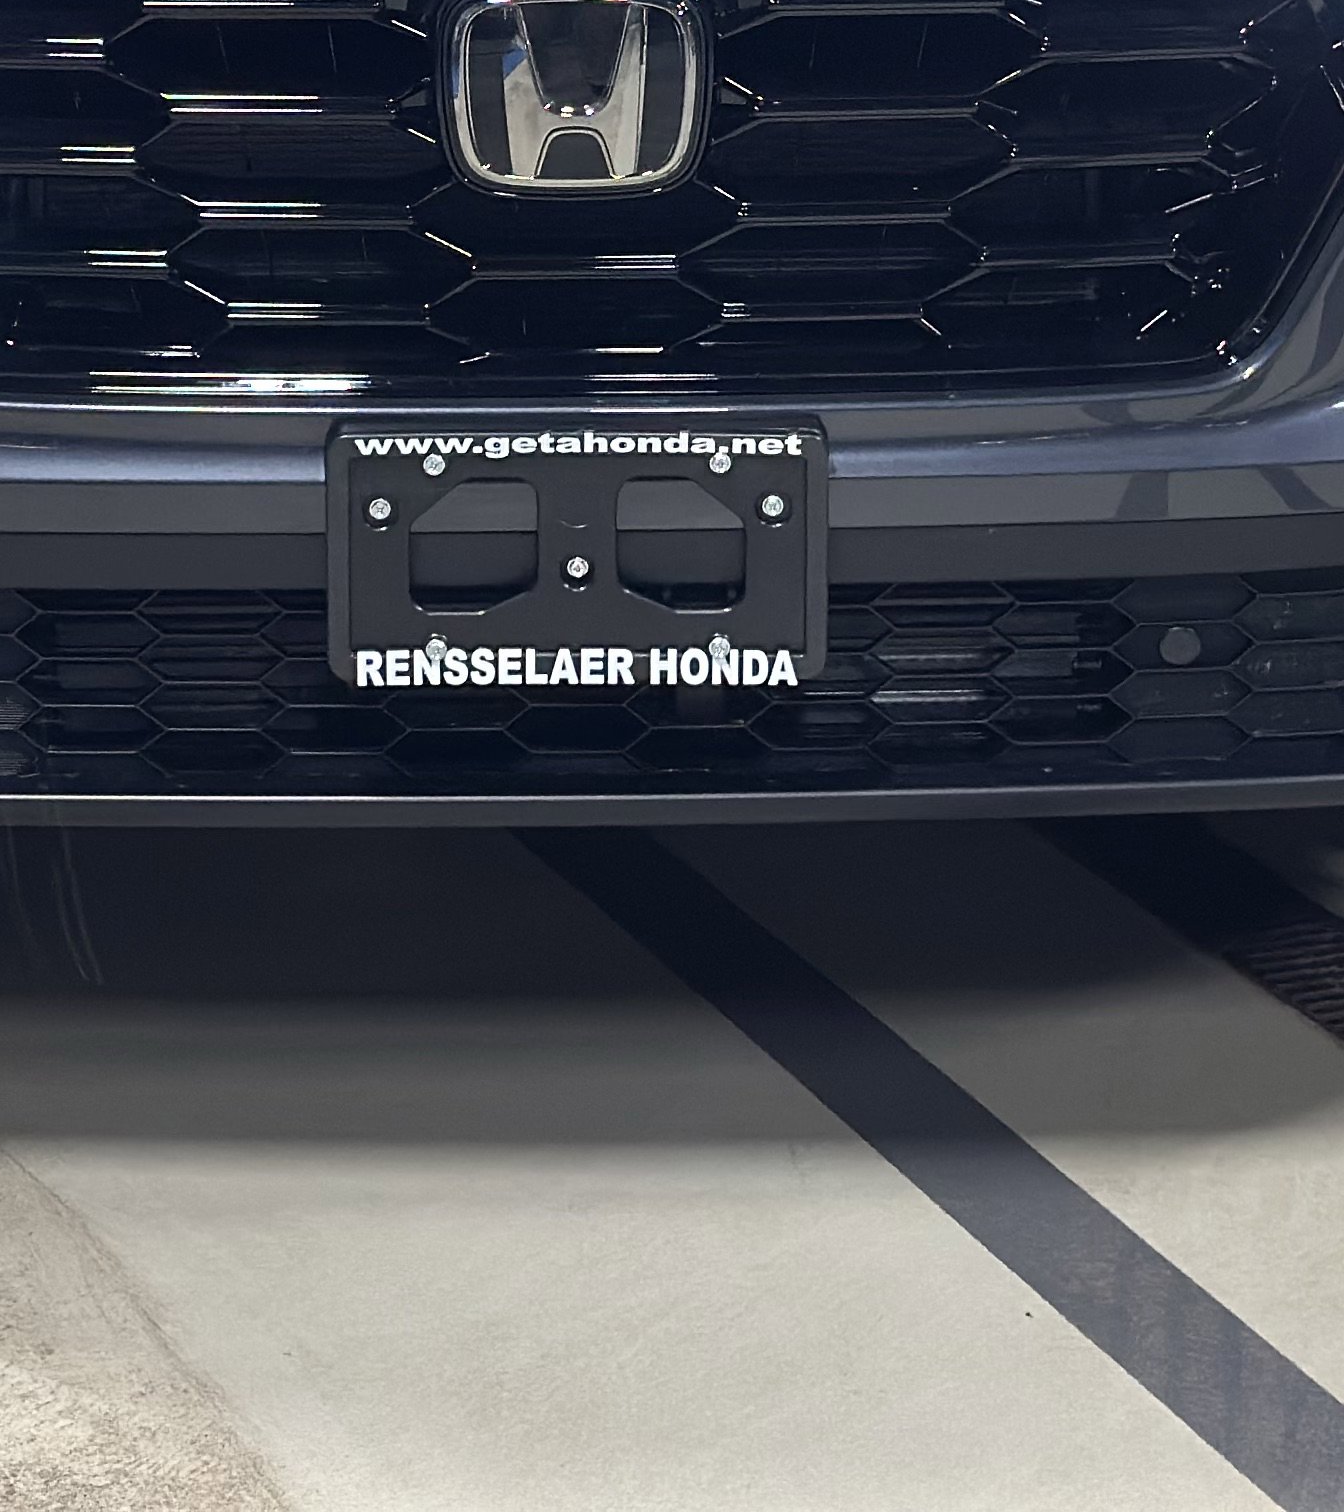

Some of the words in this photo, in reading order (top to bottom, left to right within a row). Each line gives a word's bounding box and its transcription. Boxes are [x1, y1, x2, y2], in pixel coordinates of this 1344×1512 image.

[354, 430, 803, 459] www.getahonda.net
[356, 647, 635, 687] RENSSELAER
[649, 648, 798, 686] HONDA
